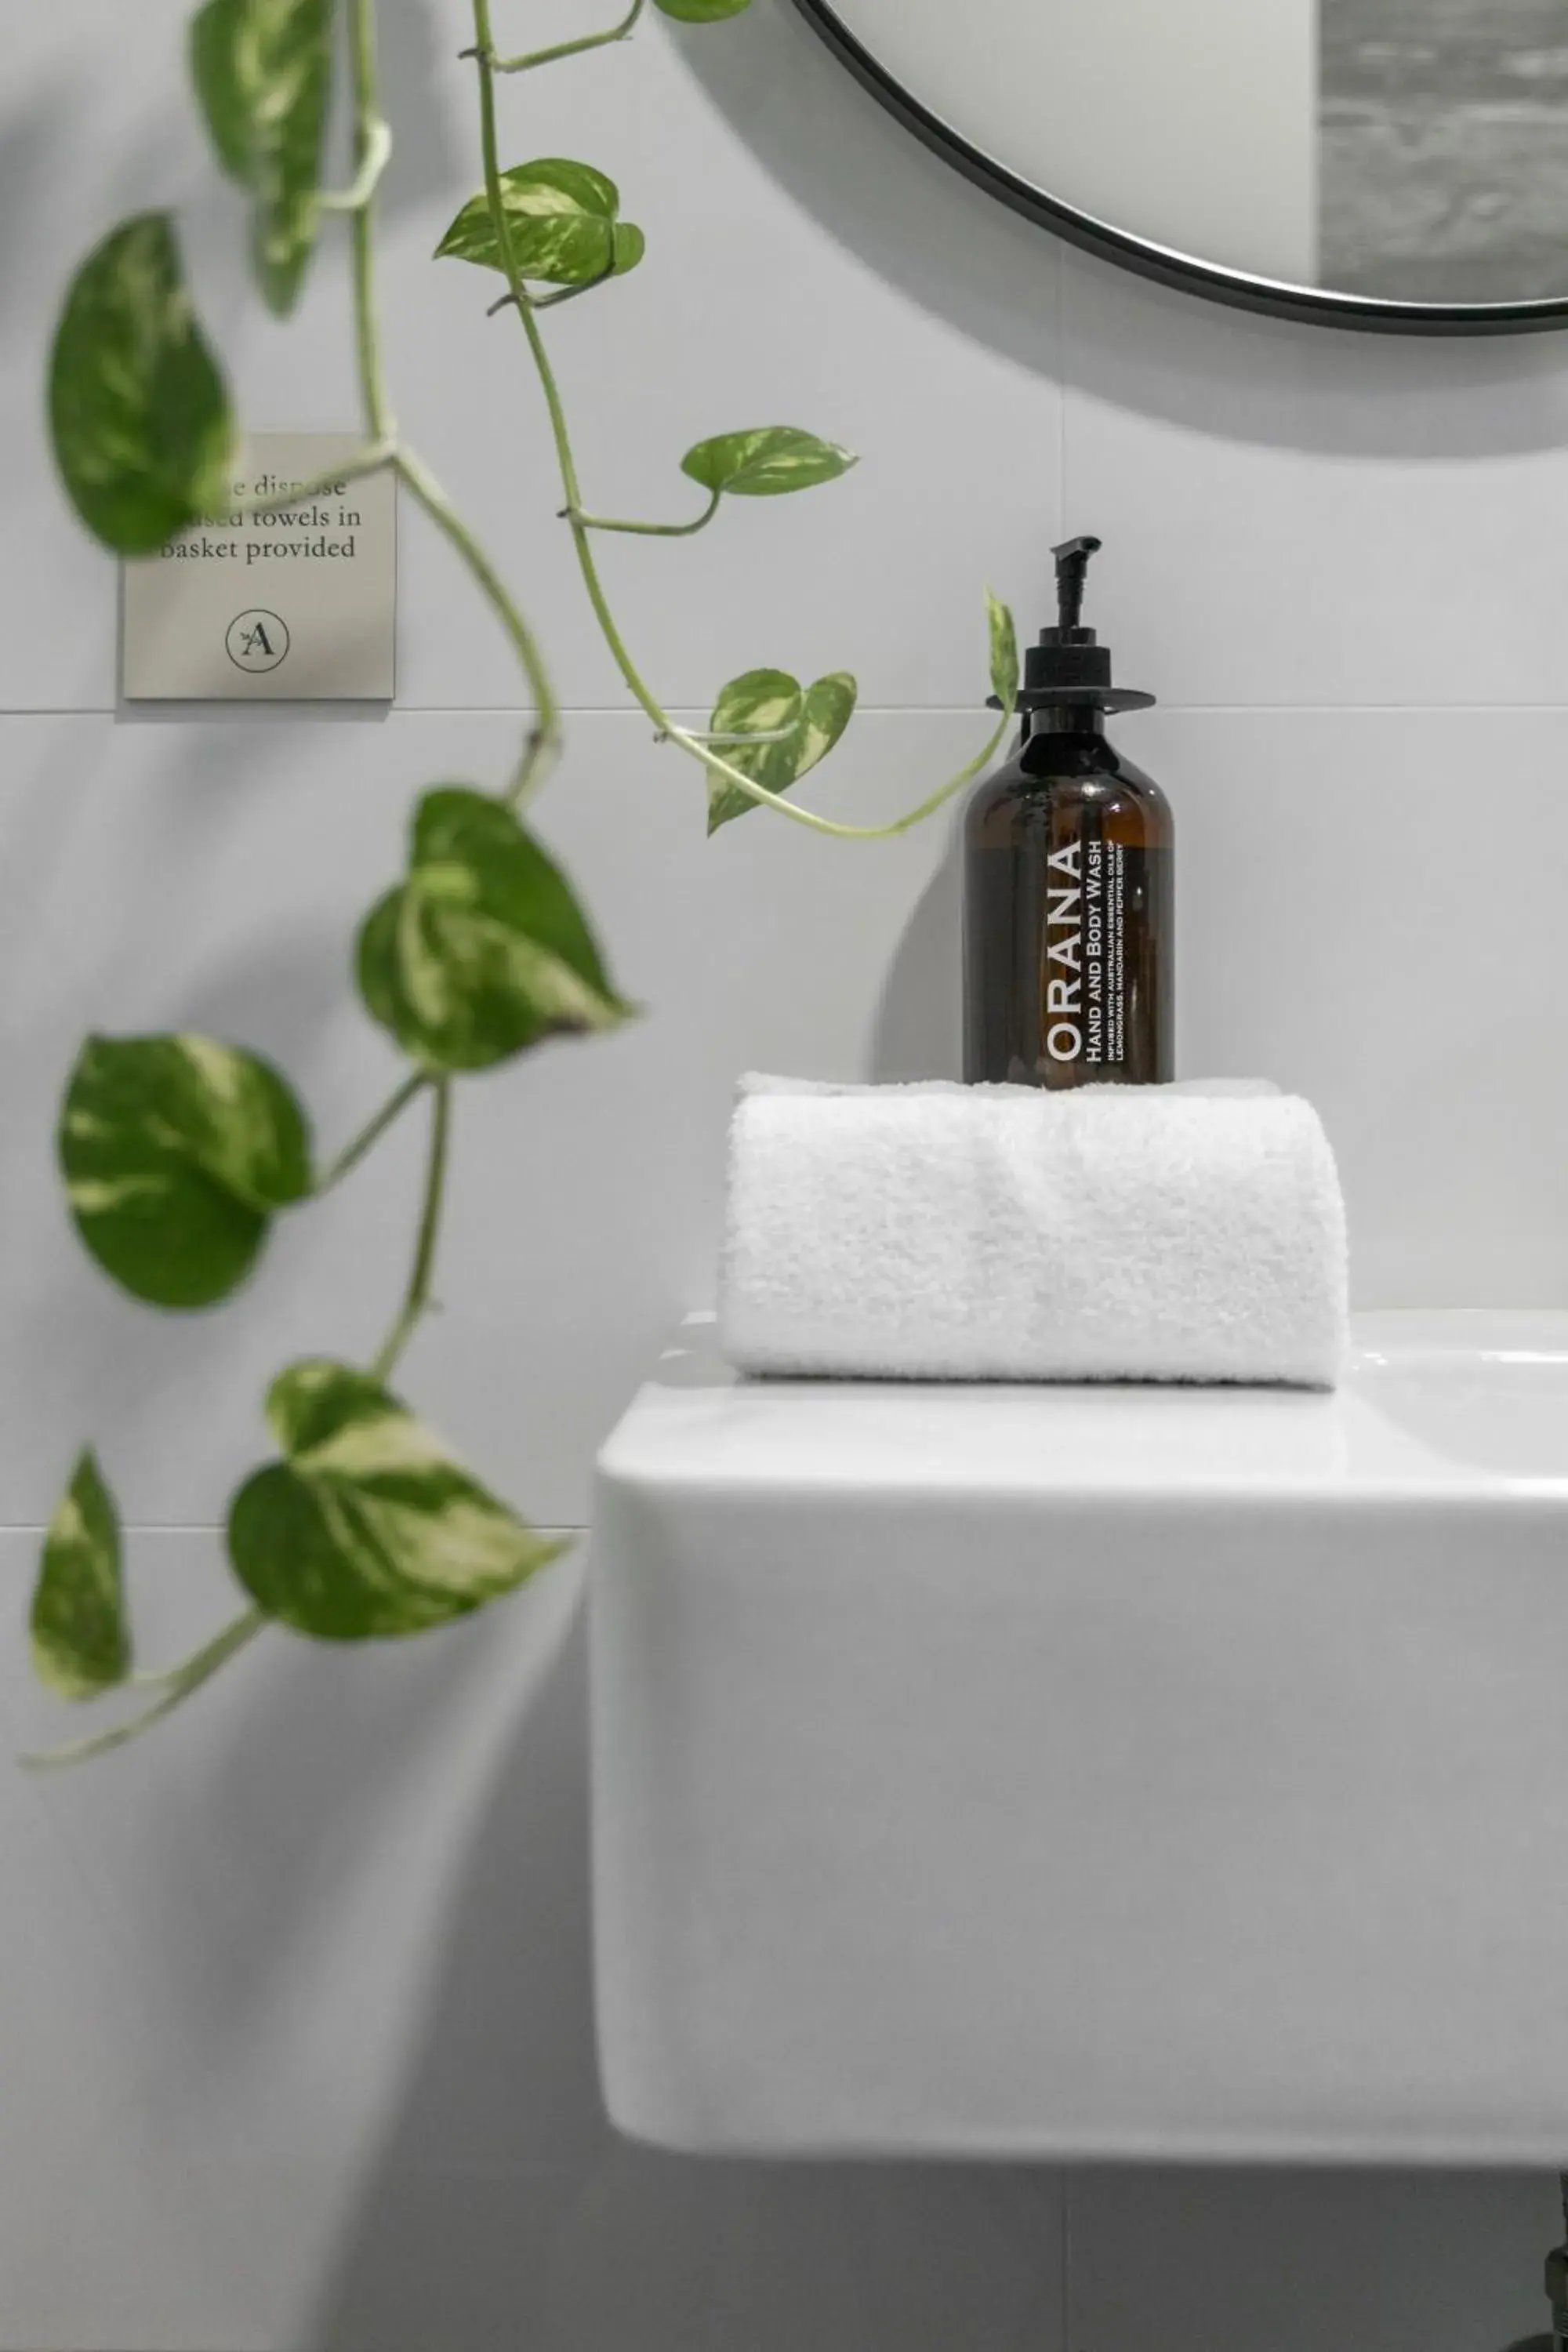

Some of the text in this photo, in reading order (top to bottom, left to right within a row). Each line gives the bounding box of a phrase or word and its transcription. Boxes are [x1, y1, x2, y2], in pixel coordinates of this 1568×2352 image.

[252, 506, 330, 528] towels
[339, 505, 362, 528] in
[161, 535, 355, 565] basket provided
[1107, 839, 1115, 853] OF
[1047, 840, 1082, 1062] ORANA
[1086, 840, 1102, 1062] HAND AND BODY WASH
